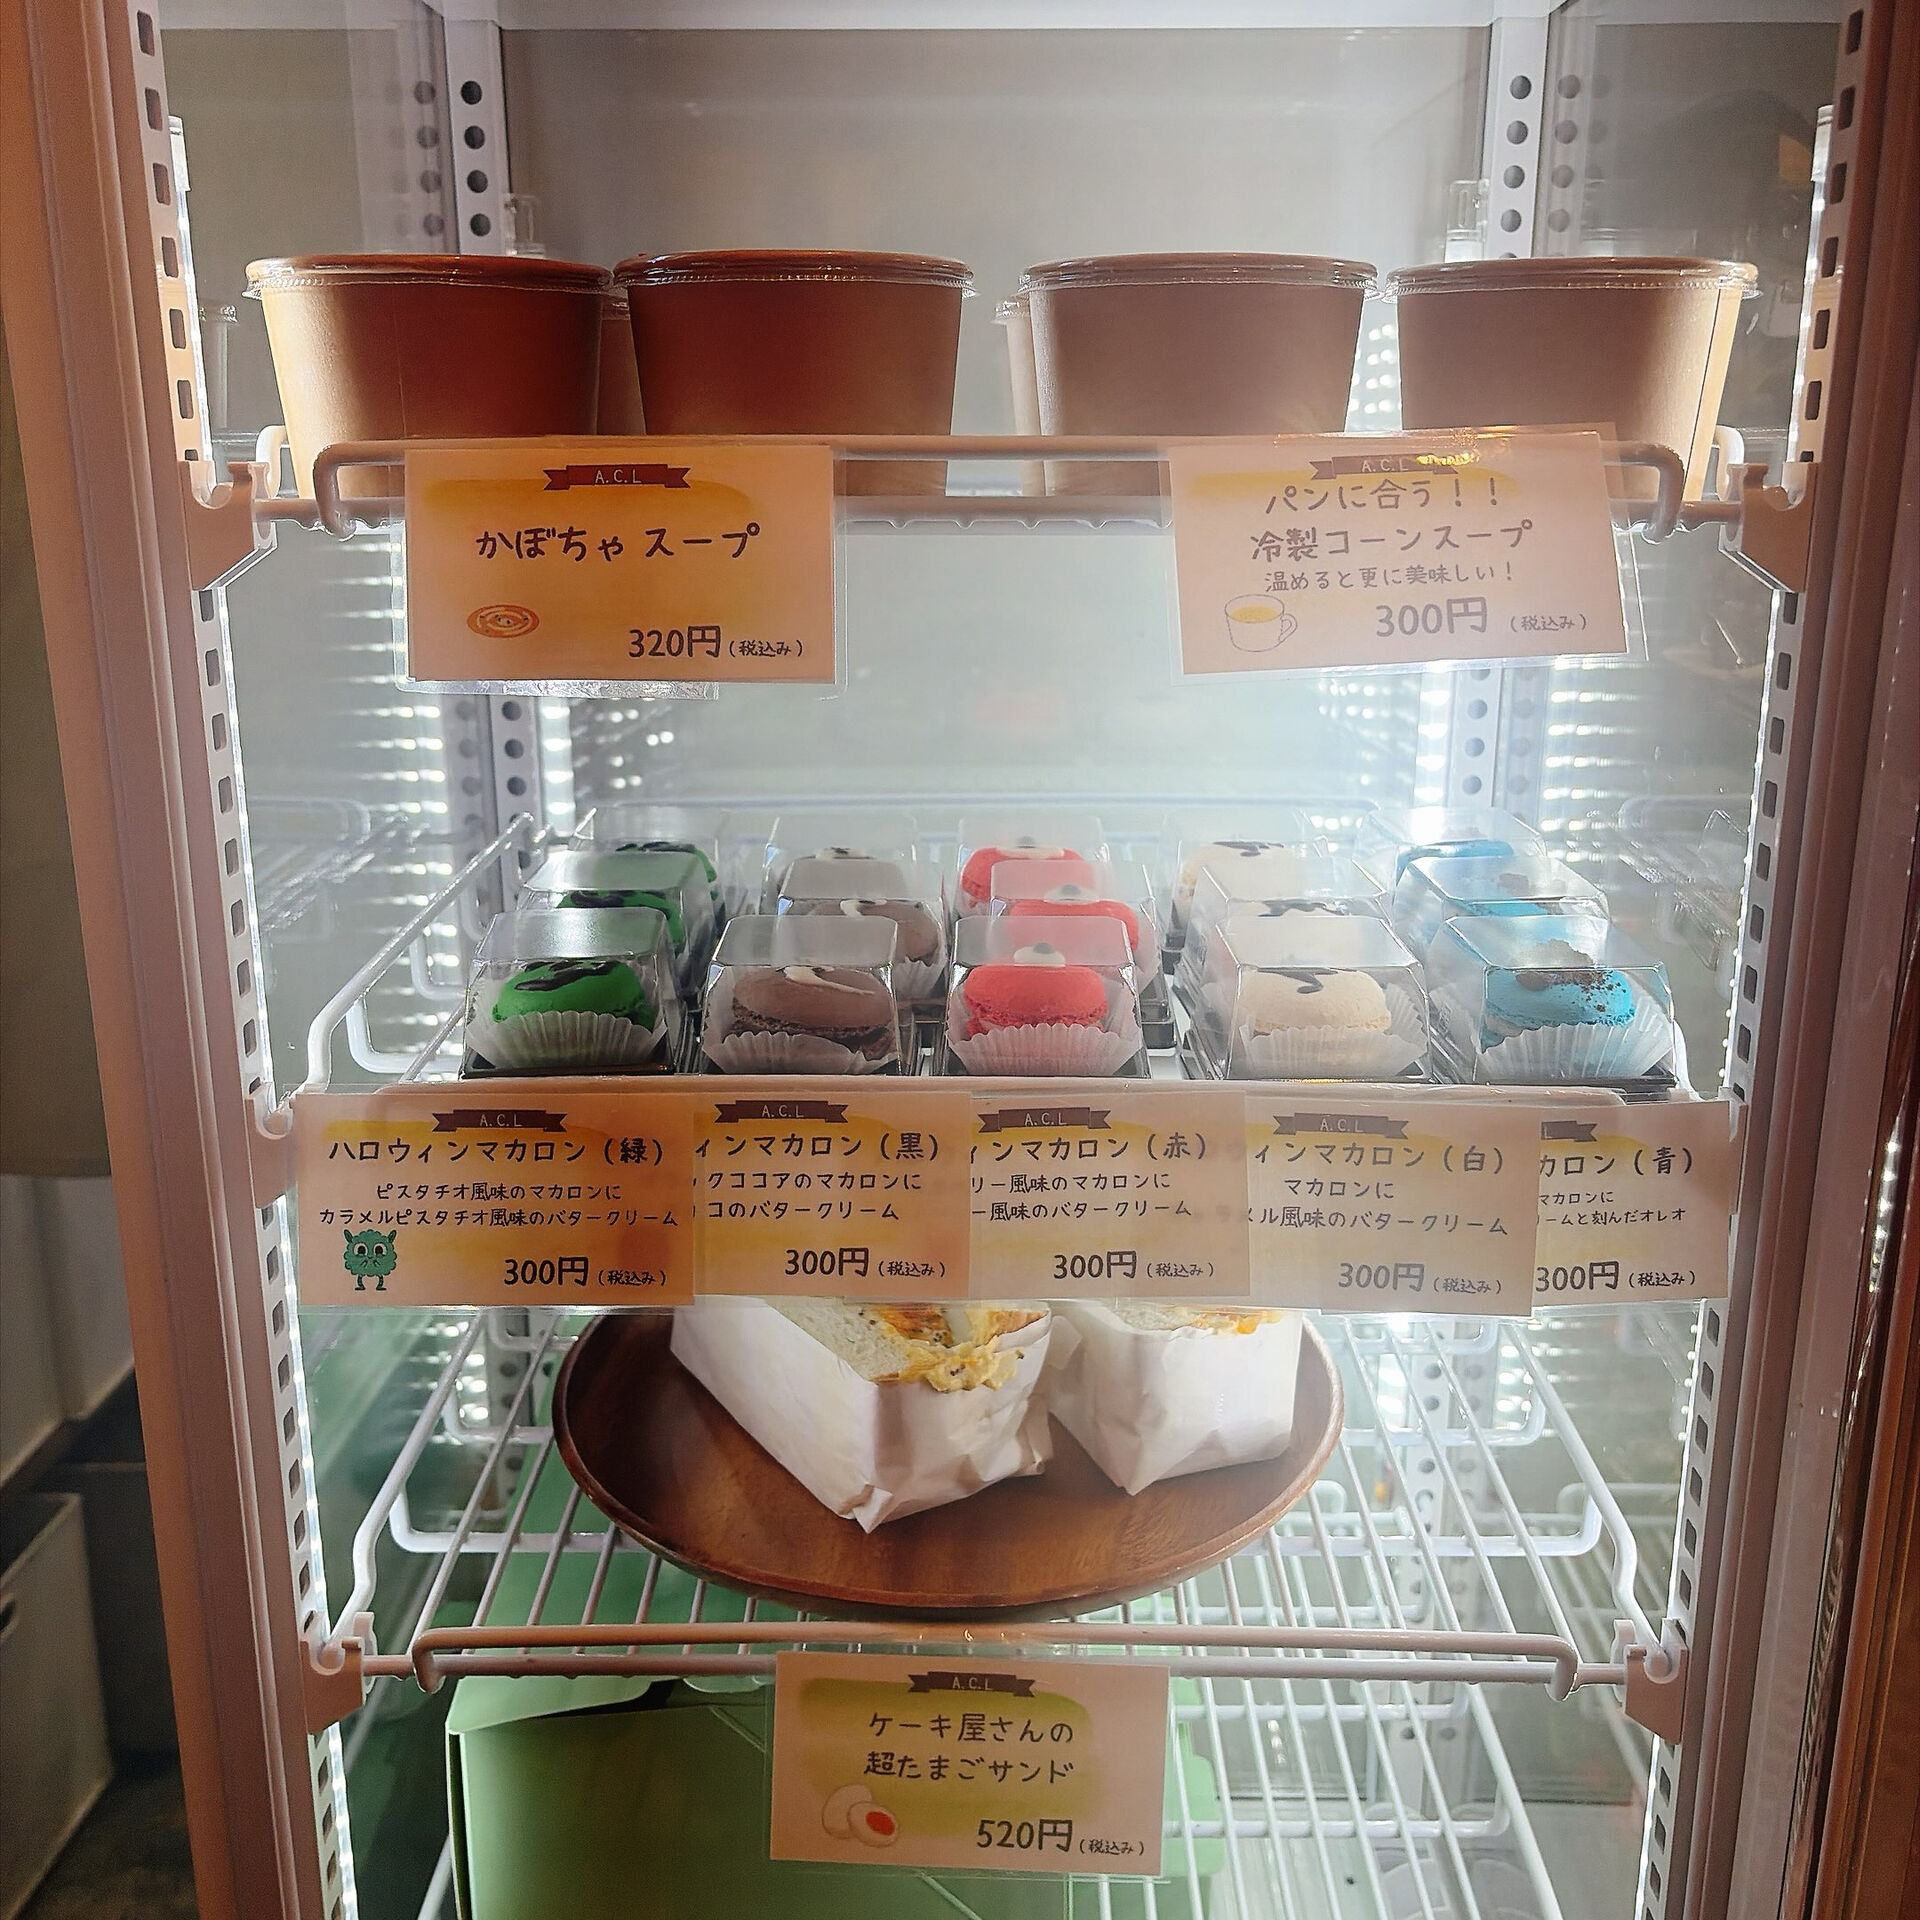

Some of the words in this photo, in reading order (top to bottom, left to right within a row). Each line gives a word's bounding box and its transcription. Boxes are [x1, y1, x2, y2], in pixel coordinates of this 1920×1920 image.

[594, 469, 642, 485] A.C.L
[1265, 477, 1498, 515] パンに合う！！
[1250, 518, 1533, 562] 冷製コーンスープ
[1264, 562, 1514, 593] 温めると更に美味しい！
[1376, 597, 1488, 638] 300円
[1510, 614, 1588, 633] （税込み）
[628, 625, 721, 658] 320円
[729, 639, 804, 657] （税込み）
[479, 1114, 523, 1127] A.C.L
[761, 1104, 804, 1119] A.C.L
[1024, 1112, 1067, 1126] A.C.L
[1320, 1118, 1364, 1133] A.C.L
[328, 1137, 664, 1165] ハロウィンマカロン（緑）
[376, 1182, 622, 1201] ピスタチオ風味のマカロンに
[693, 1171, 922, 1190] クココアのマカロンに
[971, 1173, 1171, 1194] リー風味のマカロンに
[1284, 1178, 1394, 1199] マカロンに
[319, 1208, 679, 1227] カラメルピスタチオ風味のバタークリーム
[693, 1201, 899, 1220] コのバタークリーム
[503, 1257, 589, 1286] 300円
[598, 1269, 667, 1286] （税込み）
[784, 1247, 869, 1277] 300円
[877, 1261, 946, 1278] （税込み）
[1053, 1251, 1137, 1279] 300円
[1146, 1263, 1214, 1278] （税込み）
[1535, 1261, 1620, 1292] 300円
[1629, 1270, 1696, 1288] （税込み）
[1338, 1263, 1425, 1292] 300円
[1433, 1277, 1503, 1295] （税込み）
[952, 1676, 994, 1691] A.C.L
[868, 1712, 1074, 1743] ケーキ屋さんの
[863, 1751, 1075, 1784] 超たまごサンド
[976, 1818, 1073, 1852] 520円
[1079, 1838, 1145, 1856] （税込み）
